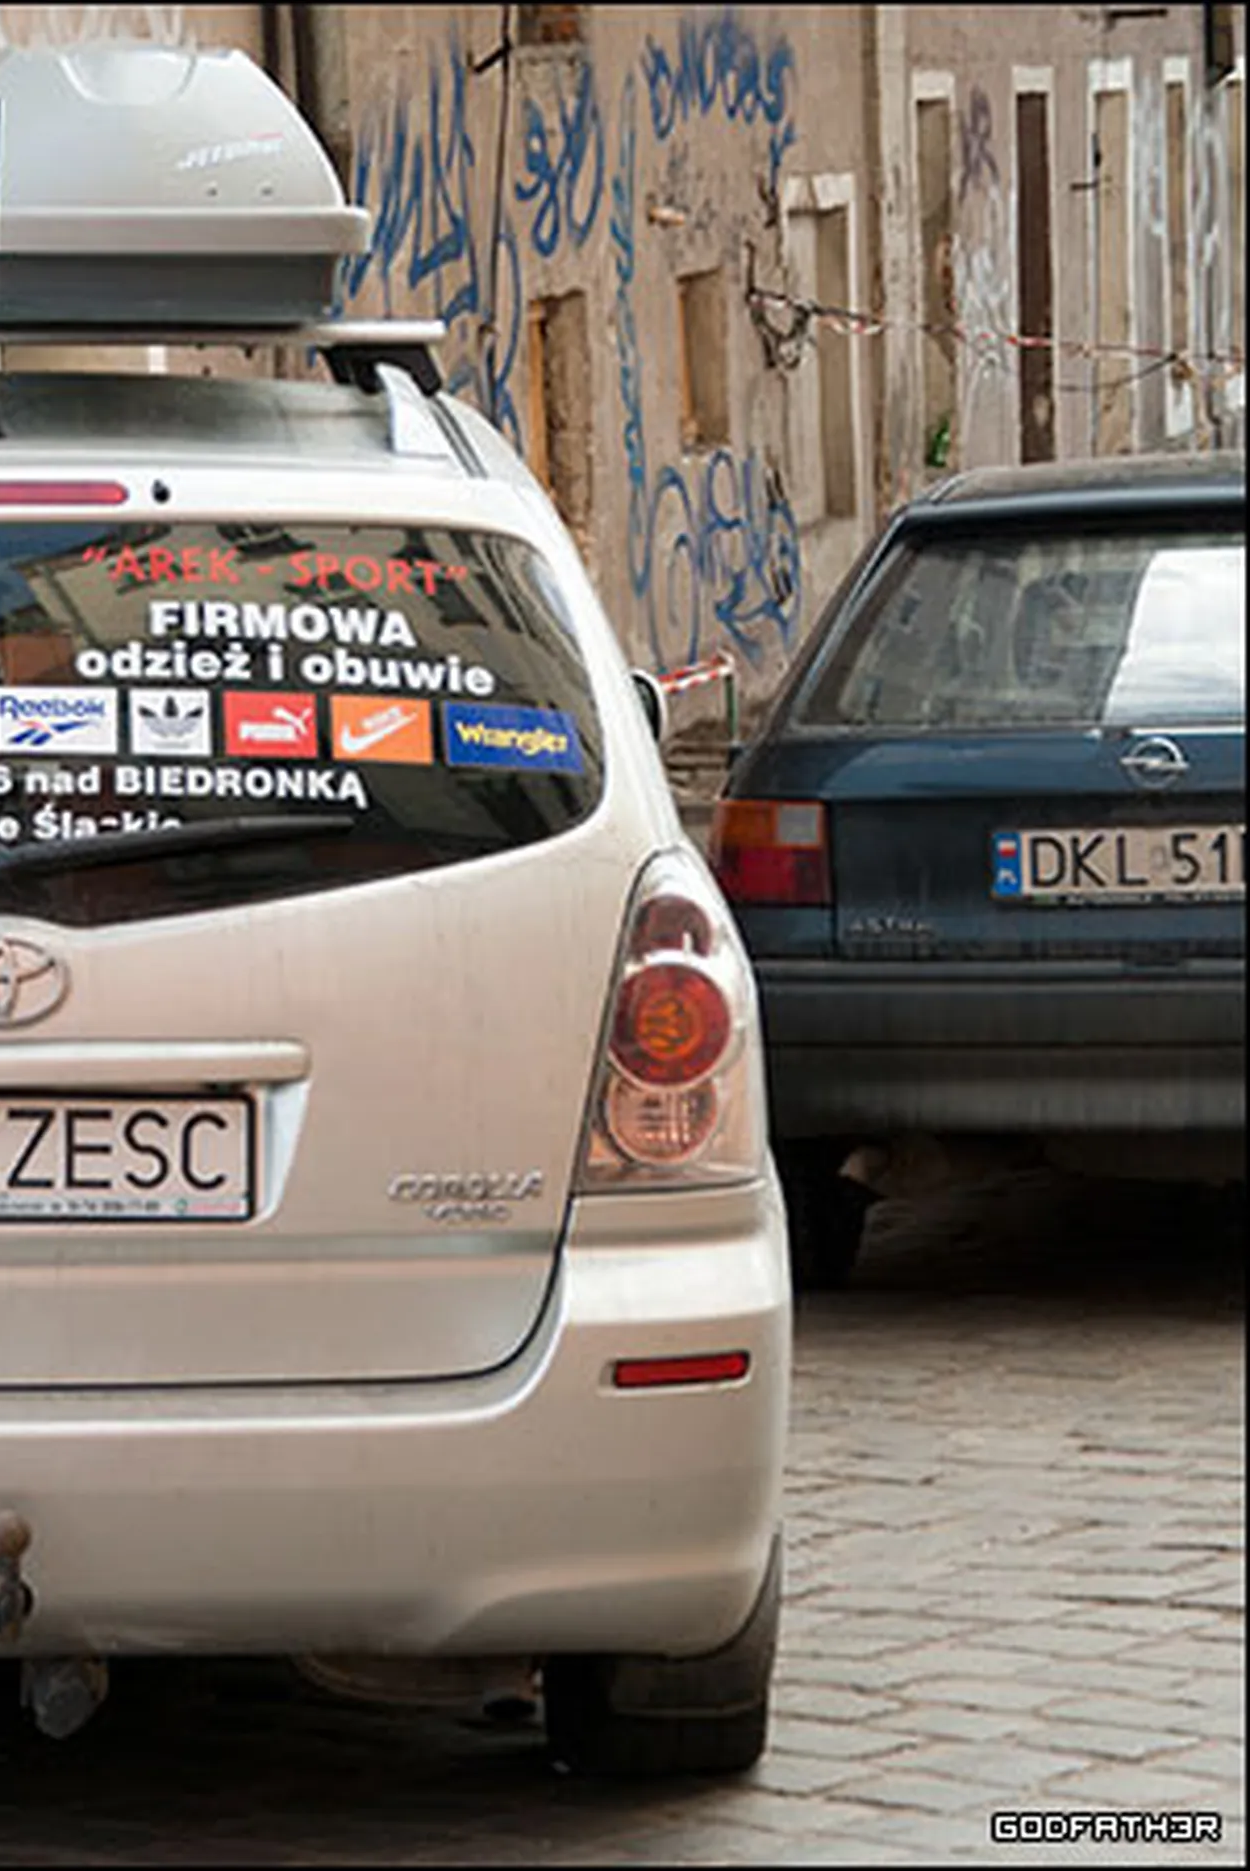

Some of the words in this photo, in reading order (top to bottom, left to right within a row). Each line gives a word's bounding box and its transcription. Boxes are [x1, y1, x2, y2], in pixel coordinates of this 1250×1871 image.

[150, 601, 416, 647] FIRMOWA
[76, 642, 250, 678] odzież
[269, 645, 283, 681] i
[300, 648, 494, 696] obuwie
[25, 765, 100, 796] nad
[115, 767, 368, 809] BIEDRONKĄ
[1030, 834, 1149, 887] DKL
